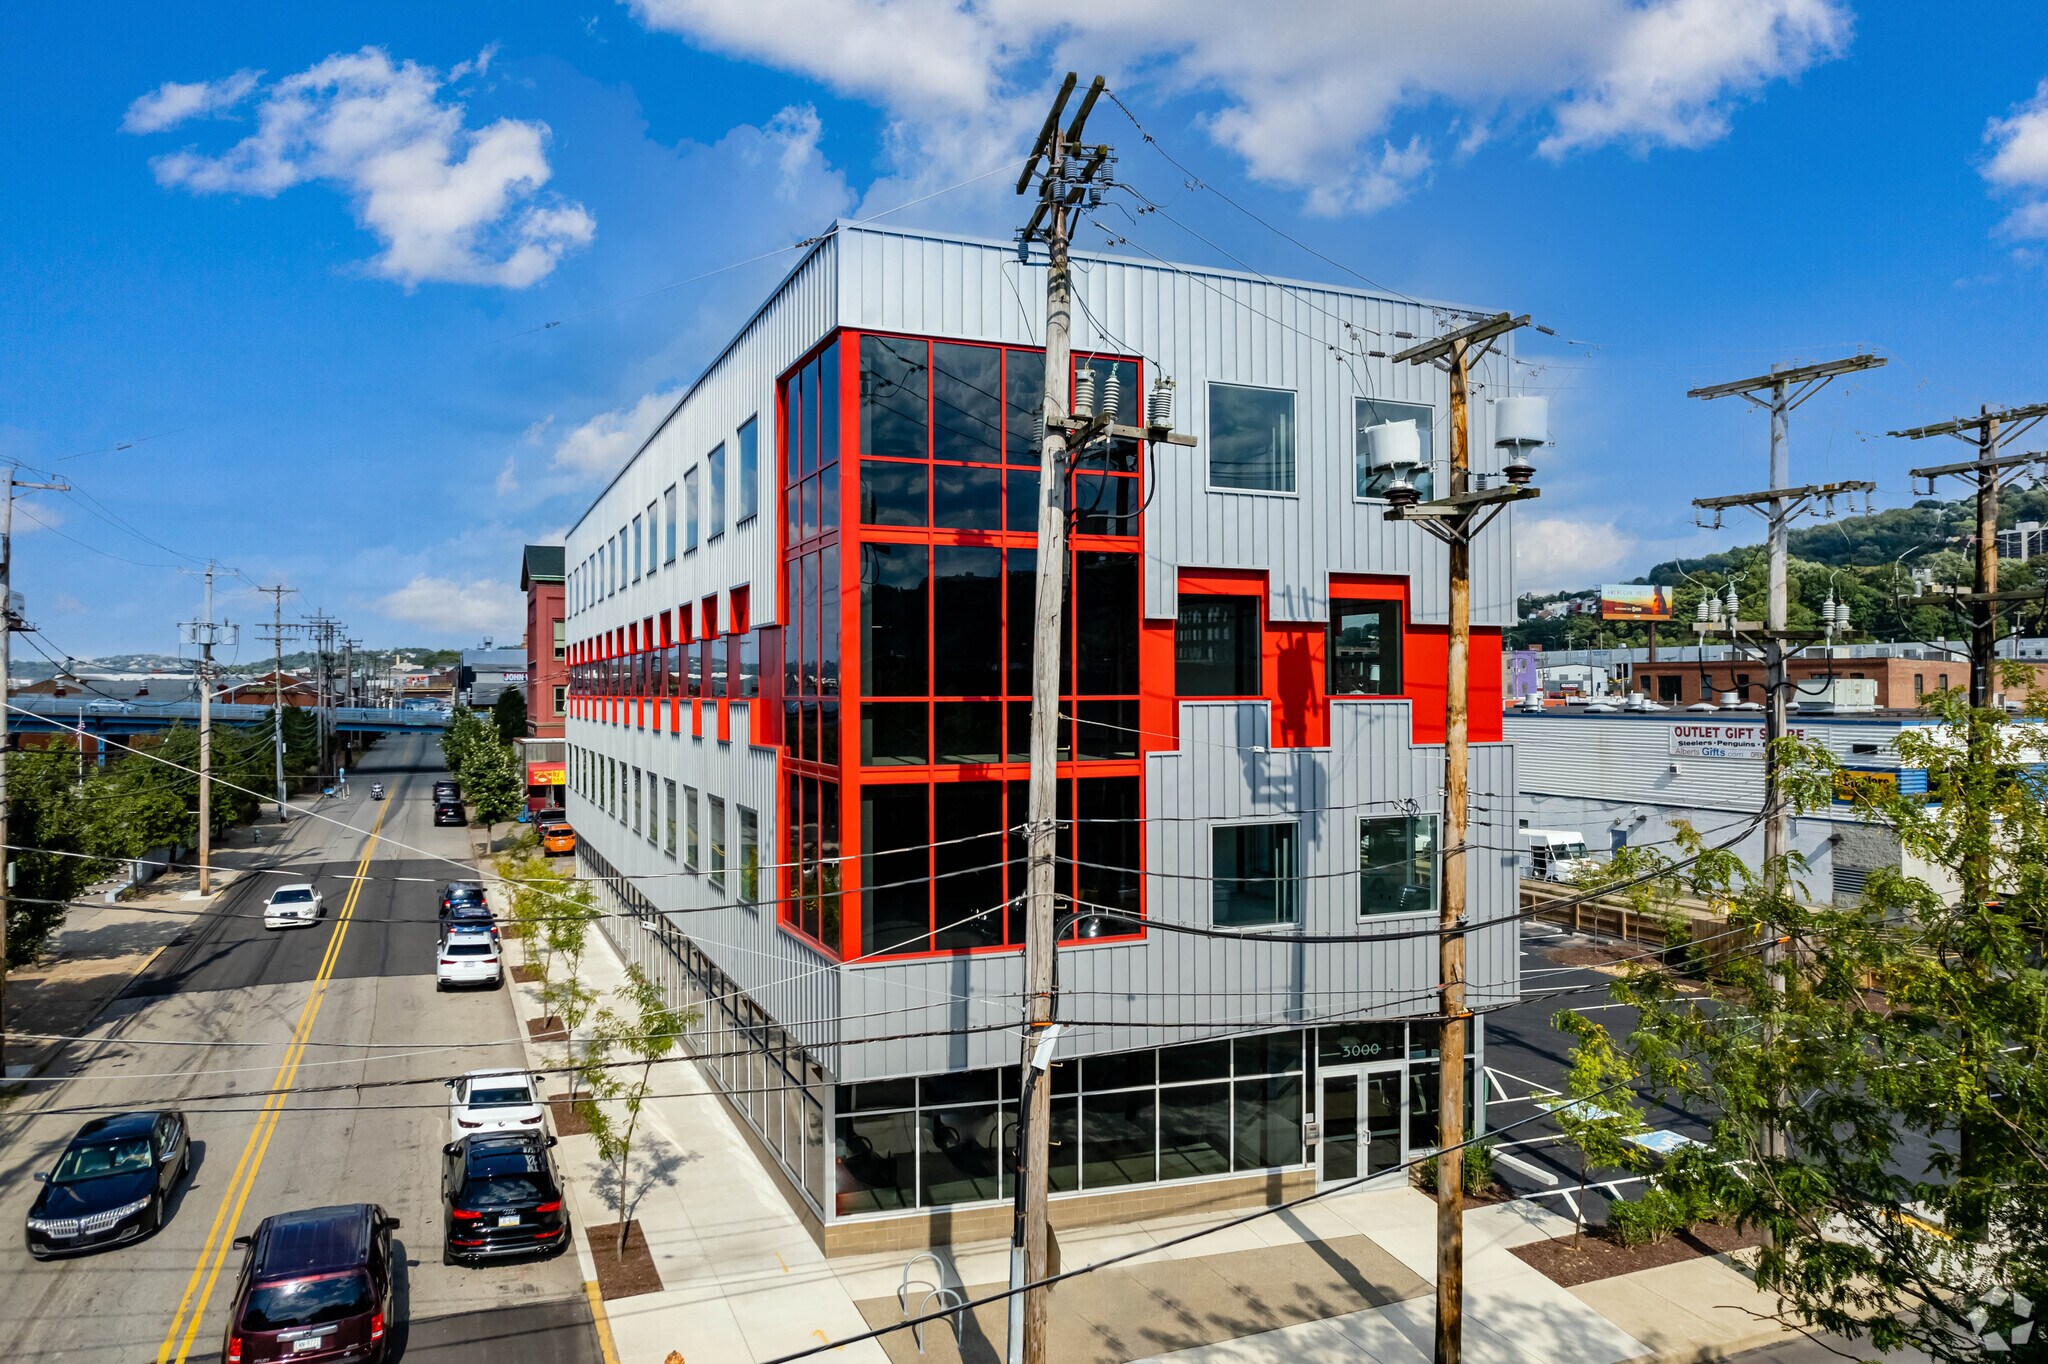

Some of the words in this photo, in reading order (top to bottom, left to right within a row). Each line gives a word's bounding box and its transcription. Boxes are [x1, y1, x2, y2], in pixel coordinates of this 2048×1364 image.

[1674, 726, 1720, 739] OUTLET
[1725, 727, 1754, 740] GIFT
[1759, 728, 1805, 741] SRE
[1716, 740, 1756, 748] Penguins
[1675, 748, 1700, 757] Alberts
[1342, 1043, 1380, 1058] 3000
